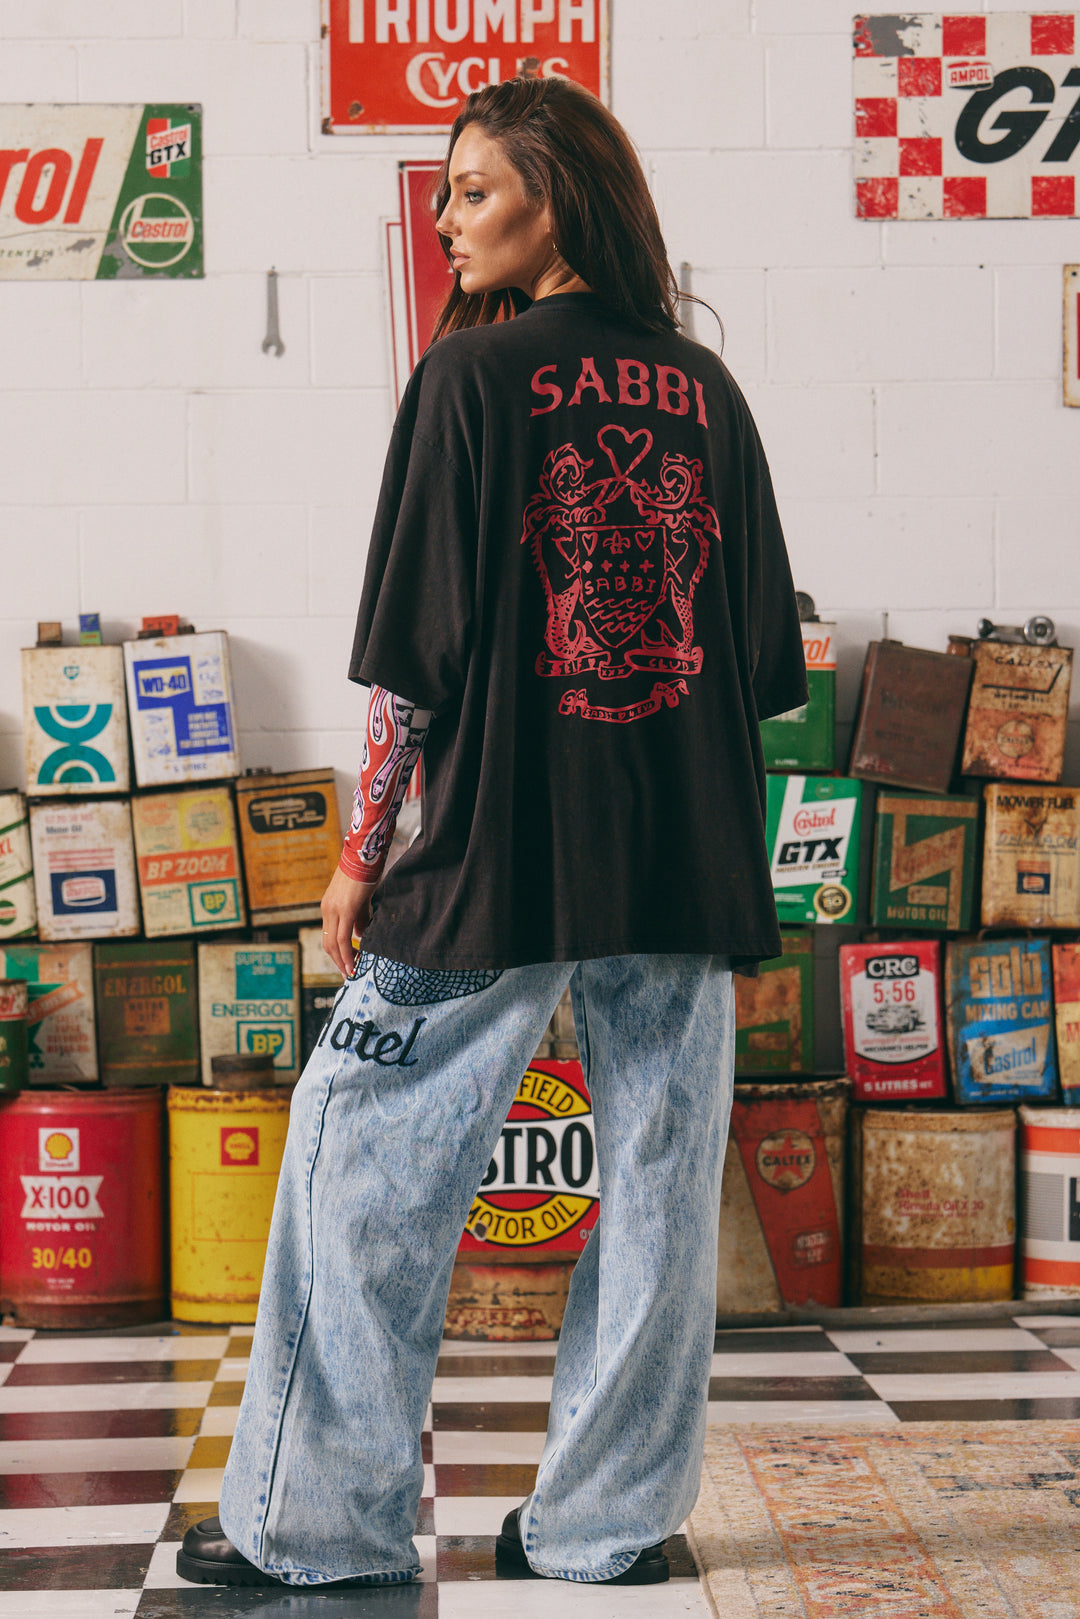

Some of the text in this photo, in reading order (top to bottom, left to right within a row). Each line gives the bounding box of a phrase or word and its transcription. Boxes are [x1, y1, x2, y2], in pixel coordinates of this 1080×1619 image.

[347, 0, 595, 43] TRIUMPH
[951, 68, 990, 83] AMPOL
[150, 127, 188, 149] Castrol
[150, 141, 187, 165] GTX
[131, 219, 189, 238] Castrol
[530, 357, 708, 429] SABBI
[584, 576, 656, 595] SABBI
[142, 674, 187, 694] WD-40
[793, 807, 836, 837] Castrol
[778, 837, 844, 865] GTX
[146, 853, 229, 880] BP ZOOM
[203, 893, 226, 910] BP
[887, 906, 947, 921] MOTOR OIL
[868, 957, 917, 977] CRC
[104, 974, 187, 997] ENERGOL
[211, 1003, 293, 1017] ENERGOL
[966, 1003, 1018, 1022] MIXING
[252, 1034, 282, 1053] BP
[983, 1037, 1036, 1075] Castrol
[874, 1079, 918, 1091] LITRES
[762, 1155, 811, 1167] CALTEX
[31, 1186, 90, 1209] X-100
[541, 1200, 578, 1230] OIL
[26, 1221, 96, 1232] MOTOR OIL
[32, 1246, 92, 1269] 30/40
